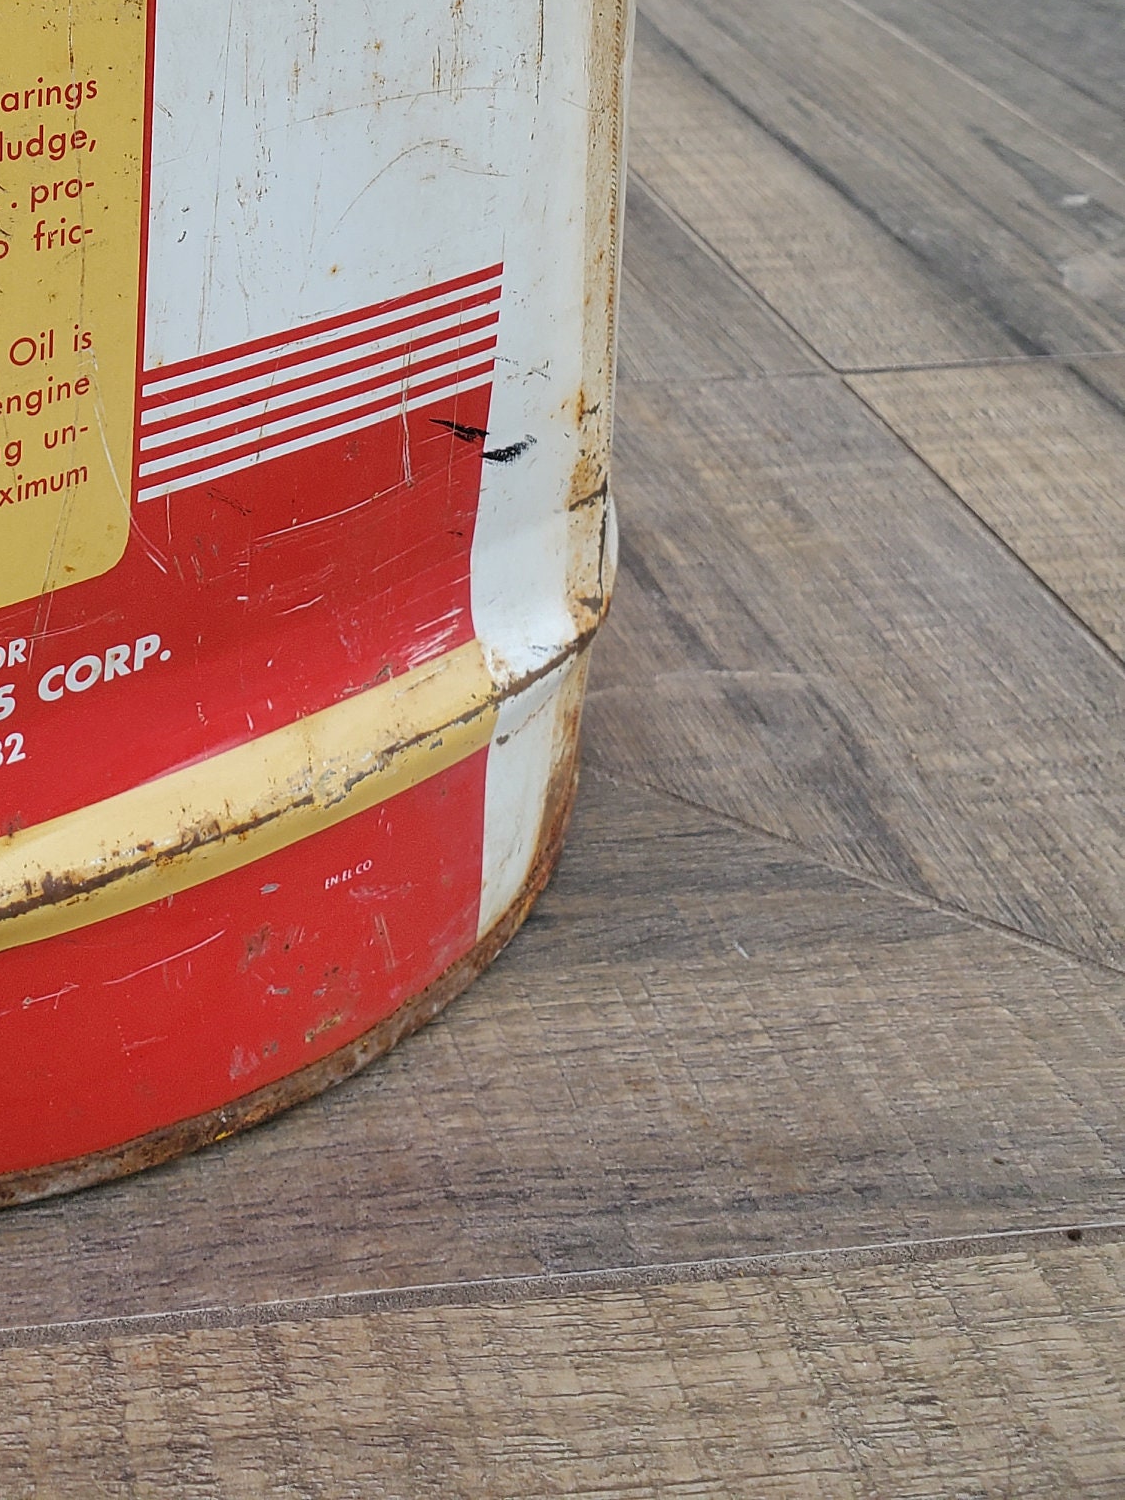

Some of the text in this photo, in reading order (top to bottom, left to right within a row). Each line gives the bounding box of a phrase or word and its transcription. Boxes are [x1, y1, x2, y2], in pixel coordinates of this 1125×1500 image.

[33, 217, 93, 252] fric-
[9, 329, 54, 367] Oil
[73, 323, 92, 352] is
[44, 425, 89, 450] un-
[37, 634, 172, 702] CORP.
